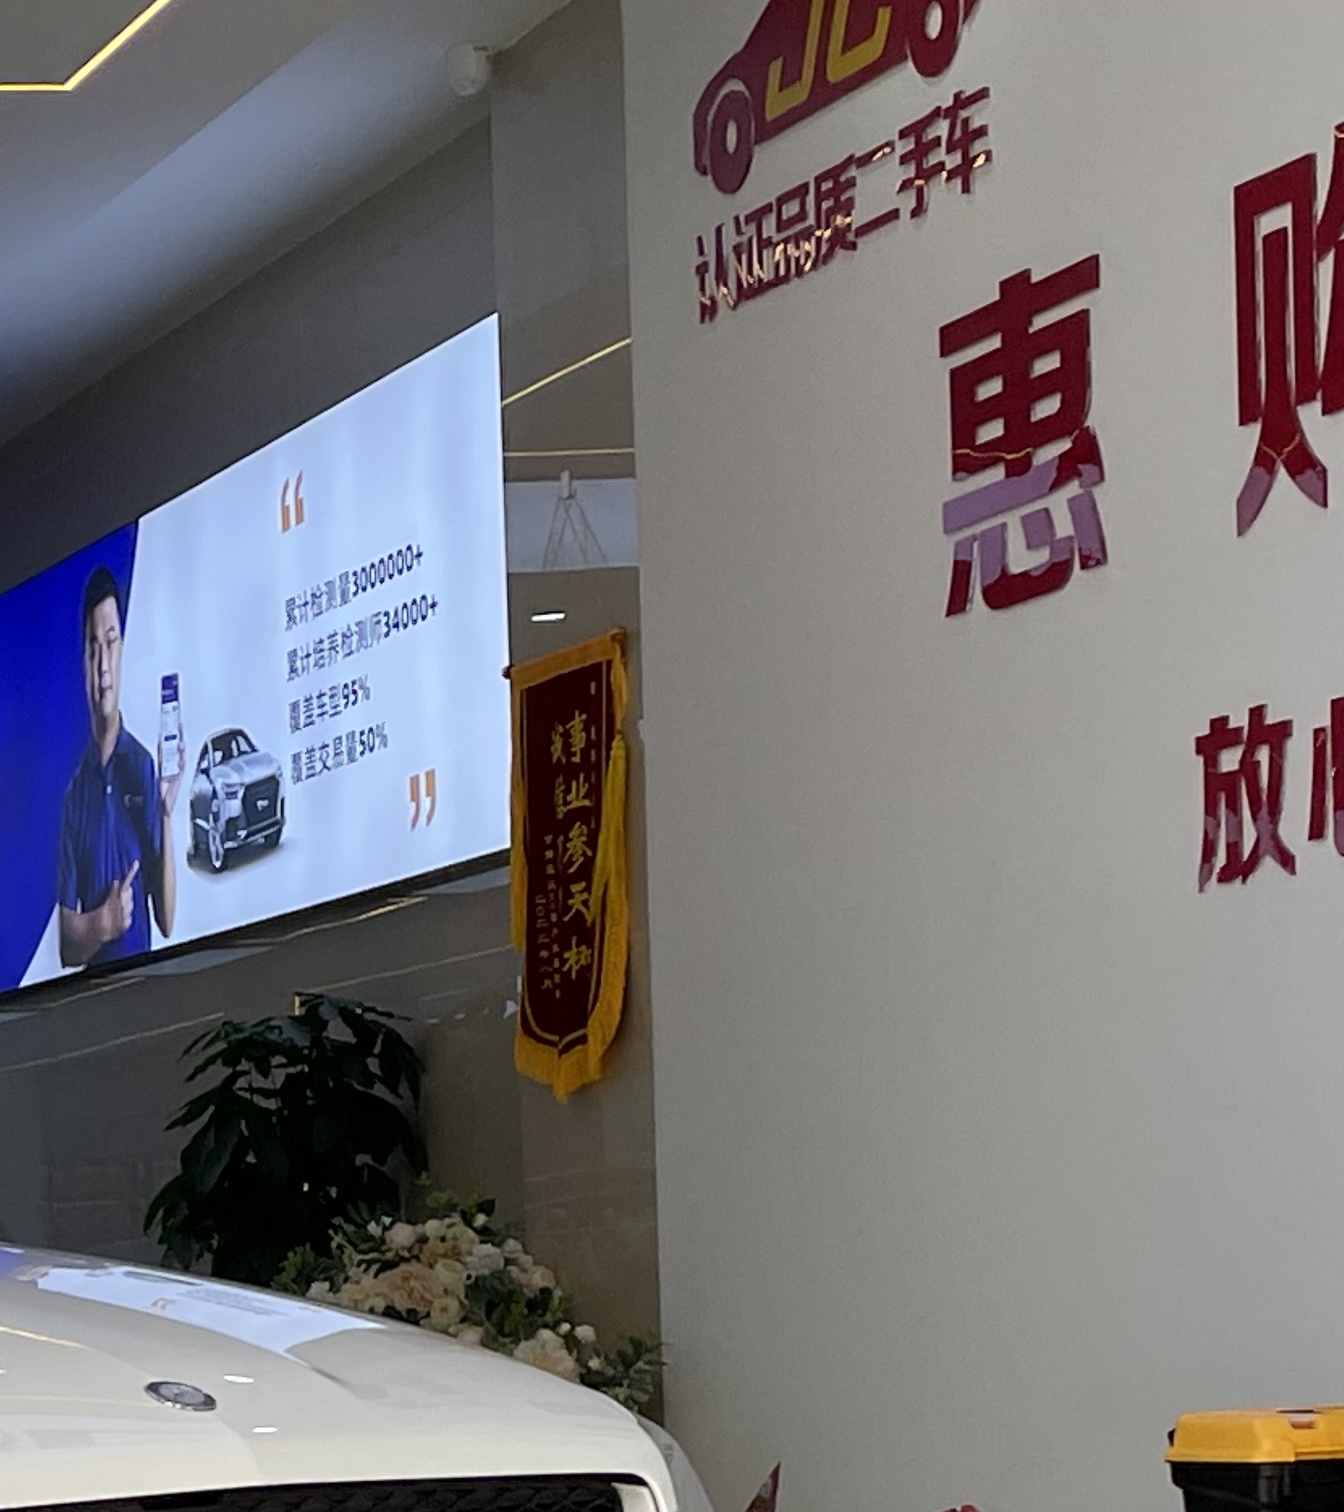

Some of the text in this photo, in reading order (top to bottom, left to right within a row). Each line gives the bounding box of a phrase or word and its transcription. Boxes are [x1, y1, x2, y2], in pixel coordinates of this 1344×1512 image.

[695, 86, 992, 324] 认证品质二手车
